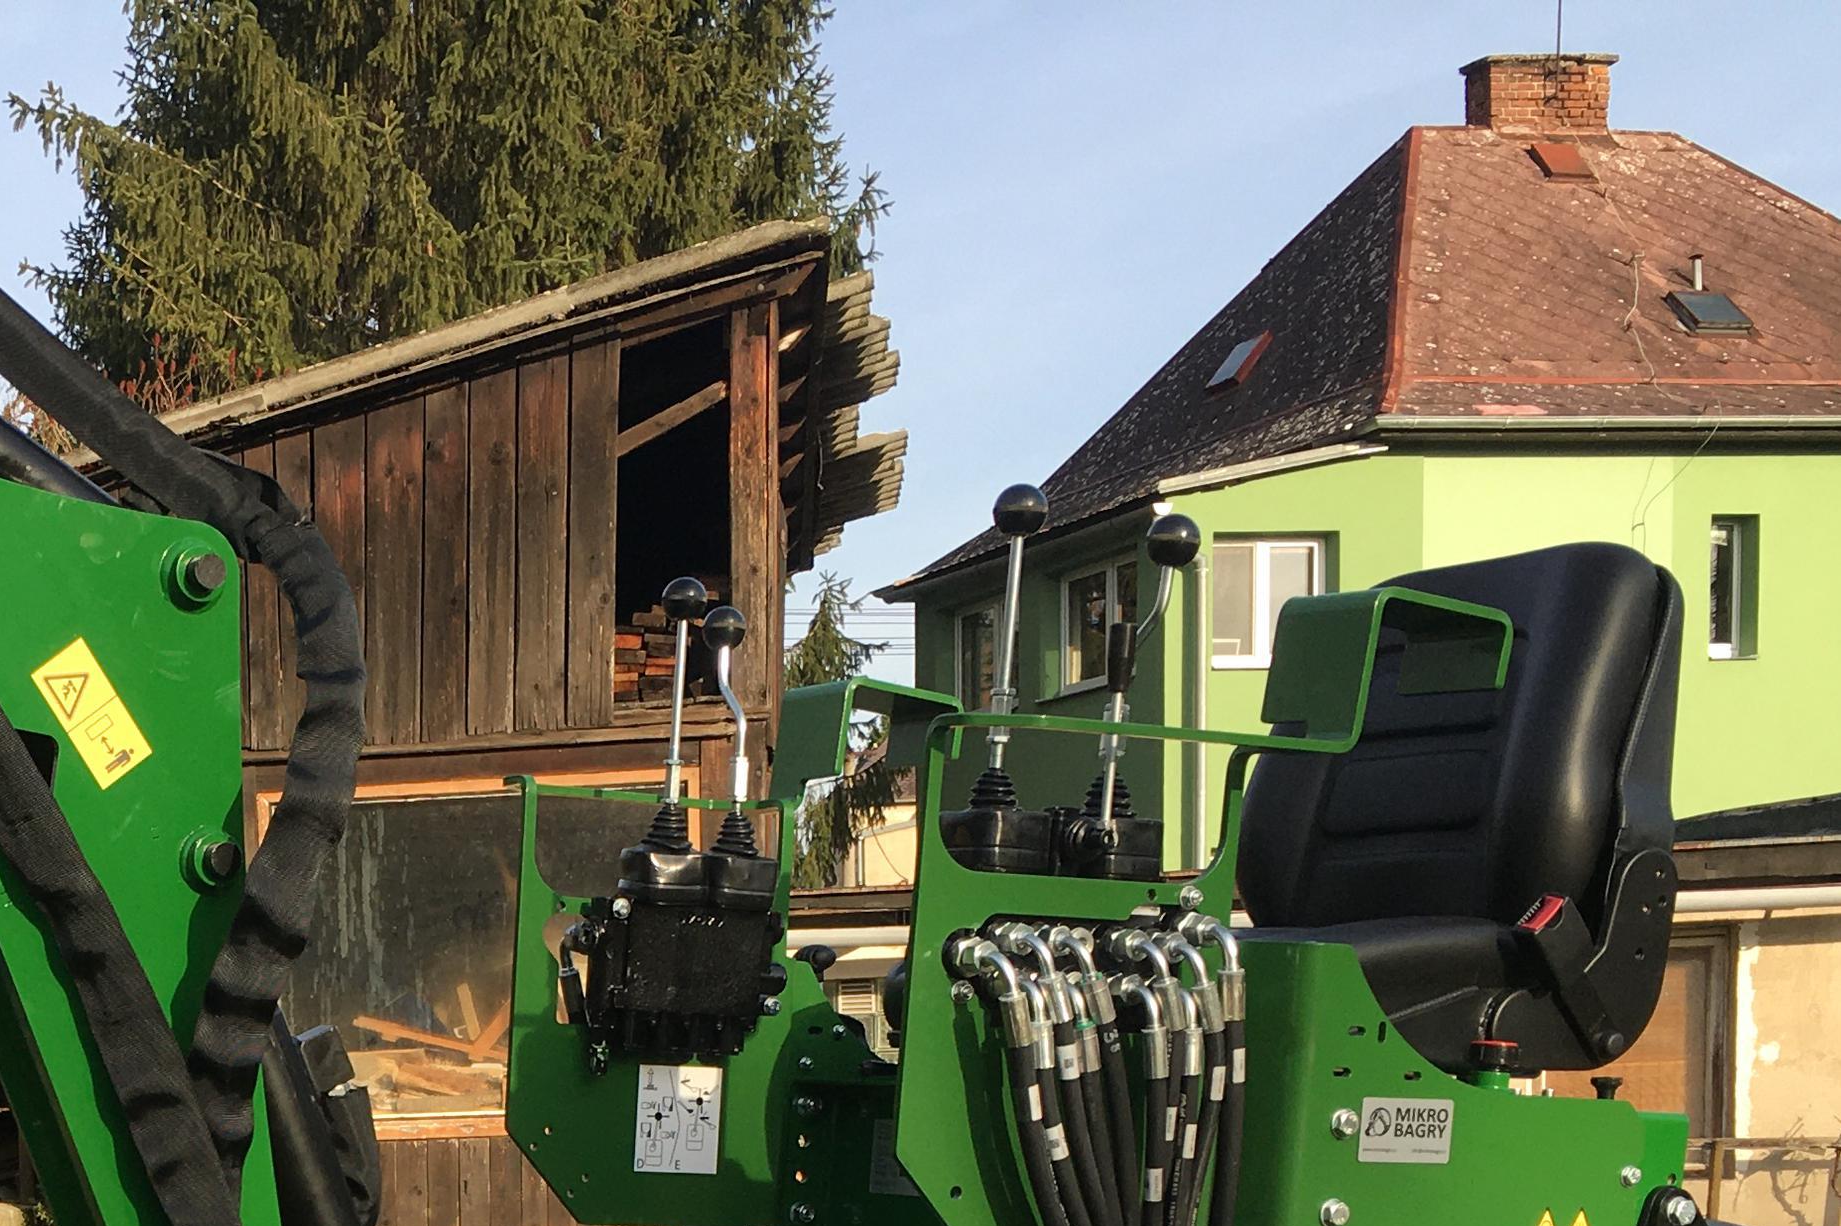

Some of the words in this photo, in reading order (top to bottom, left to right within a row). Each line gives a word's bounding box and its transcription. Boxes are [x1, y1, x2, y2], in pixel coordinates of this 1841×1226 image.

[1395, 1107, 1449, 1123] MIKRO
[1394, 1123, 1447, 1139] BAGRY
[636, 1158, 644, 1169] D
[674, 1160, 681, 1170] E
